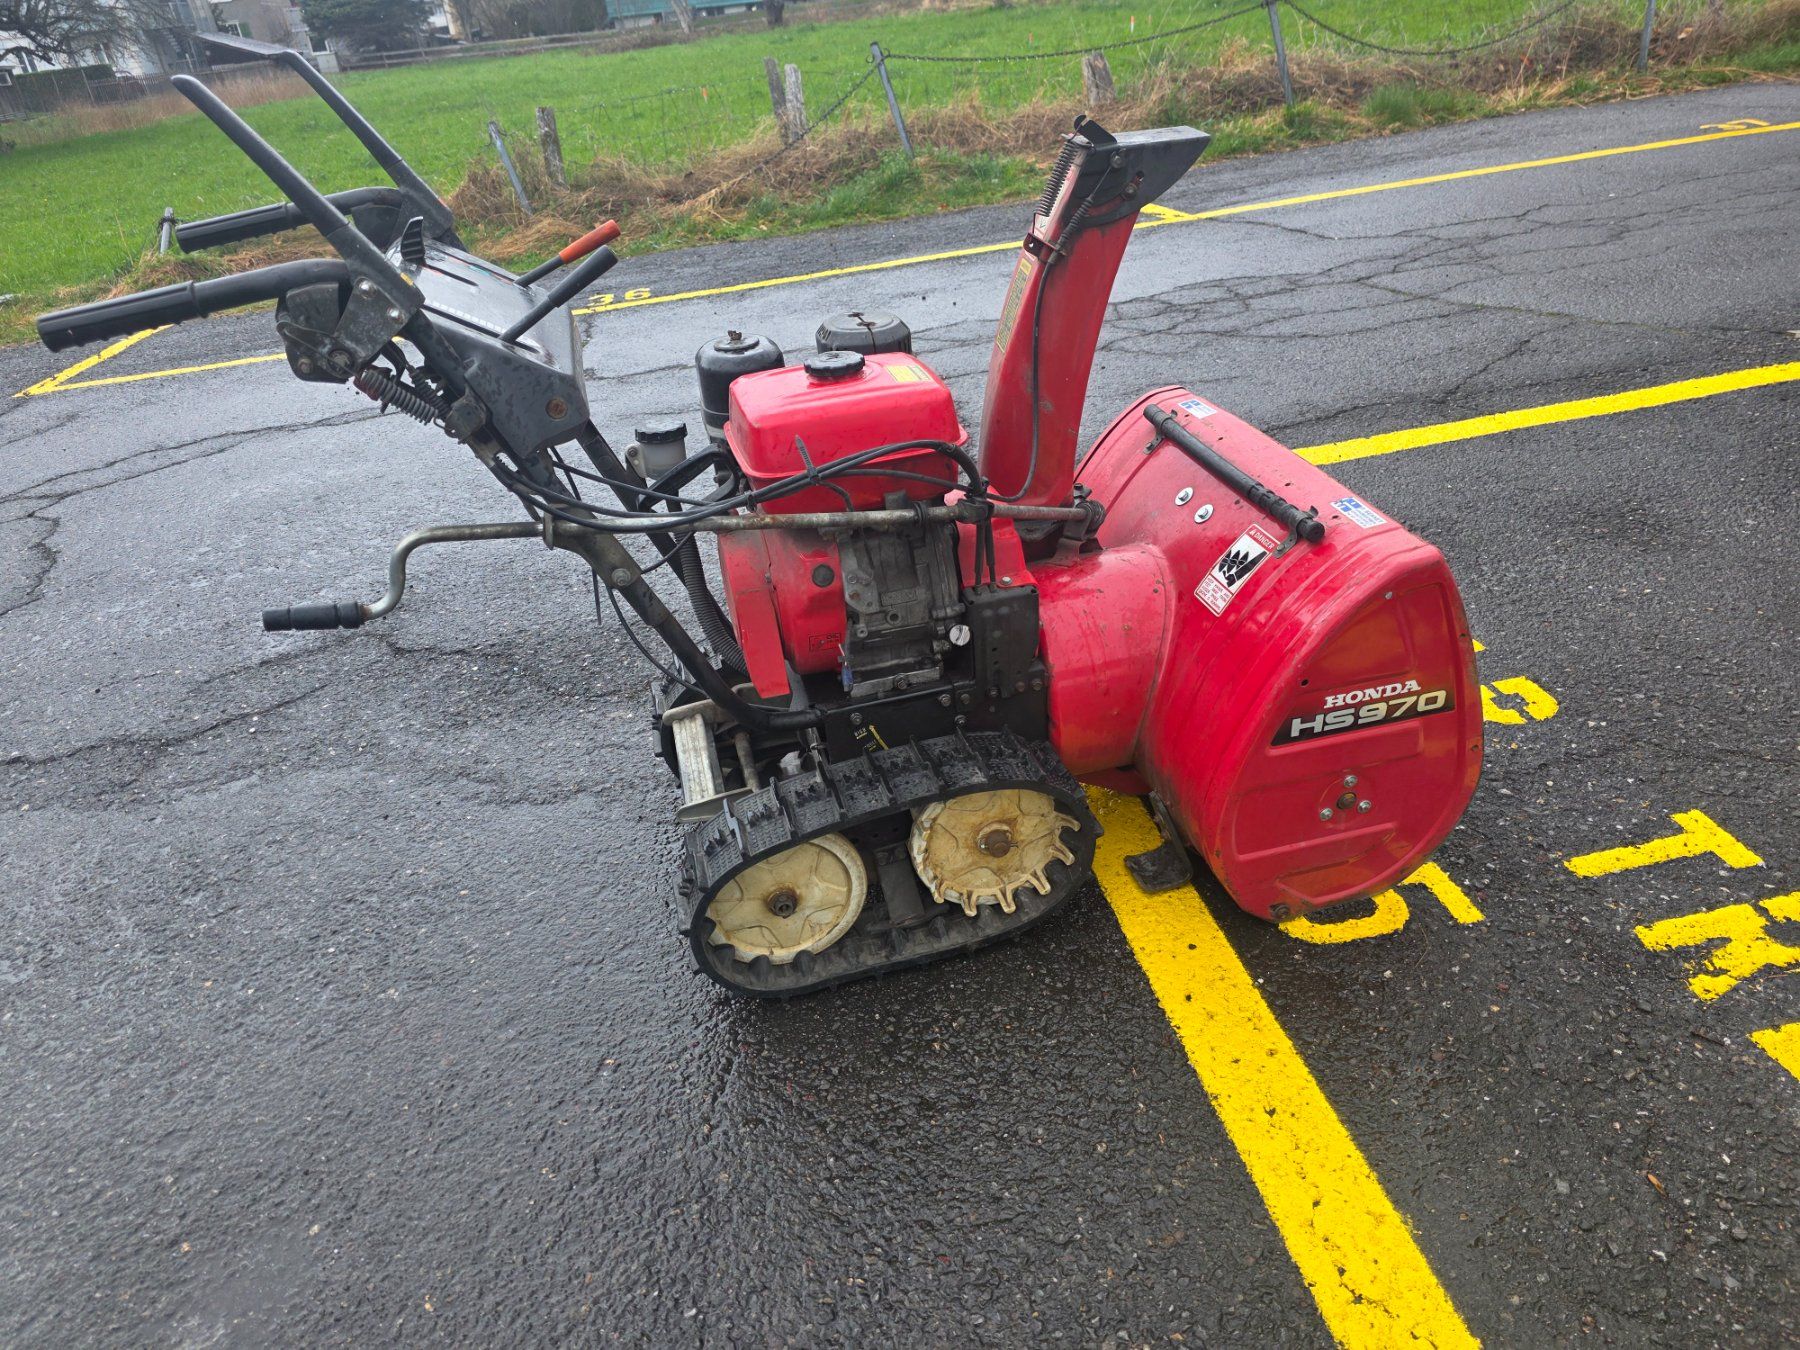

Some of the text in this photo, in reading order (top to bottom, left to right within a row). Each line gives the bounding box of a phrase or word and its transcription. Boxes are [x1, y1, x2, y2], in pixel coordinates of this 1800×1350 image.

[587, 287, 651, 307] 36
[1253, 531, 1276, 551] DANGER
[1323, 679, 1421, 709] HONDA
[1290, 689, 1448, 738] HS970
